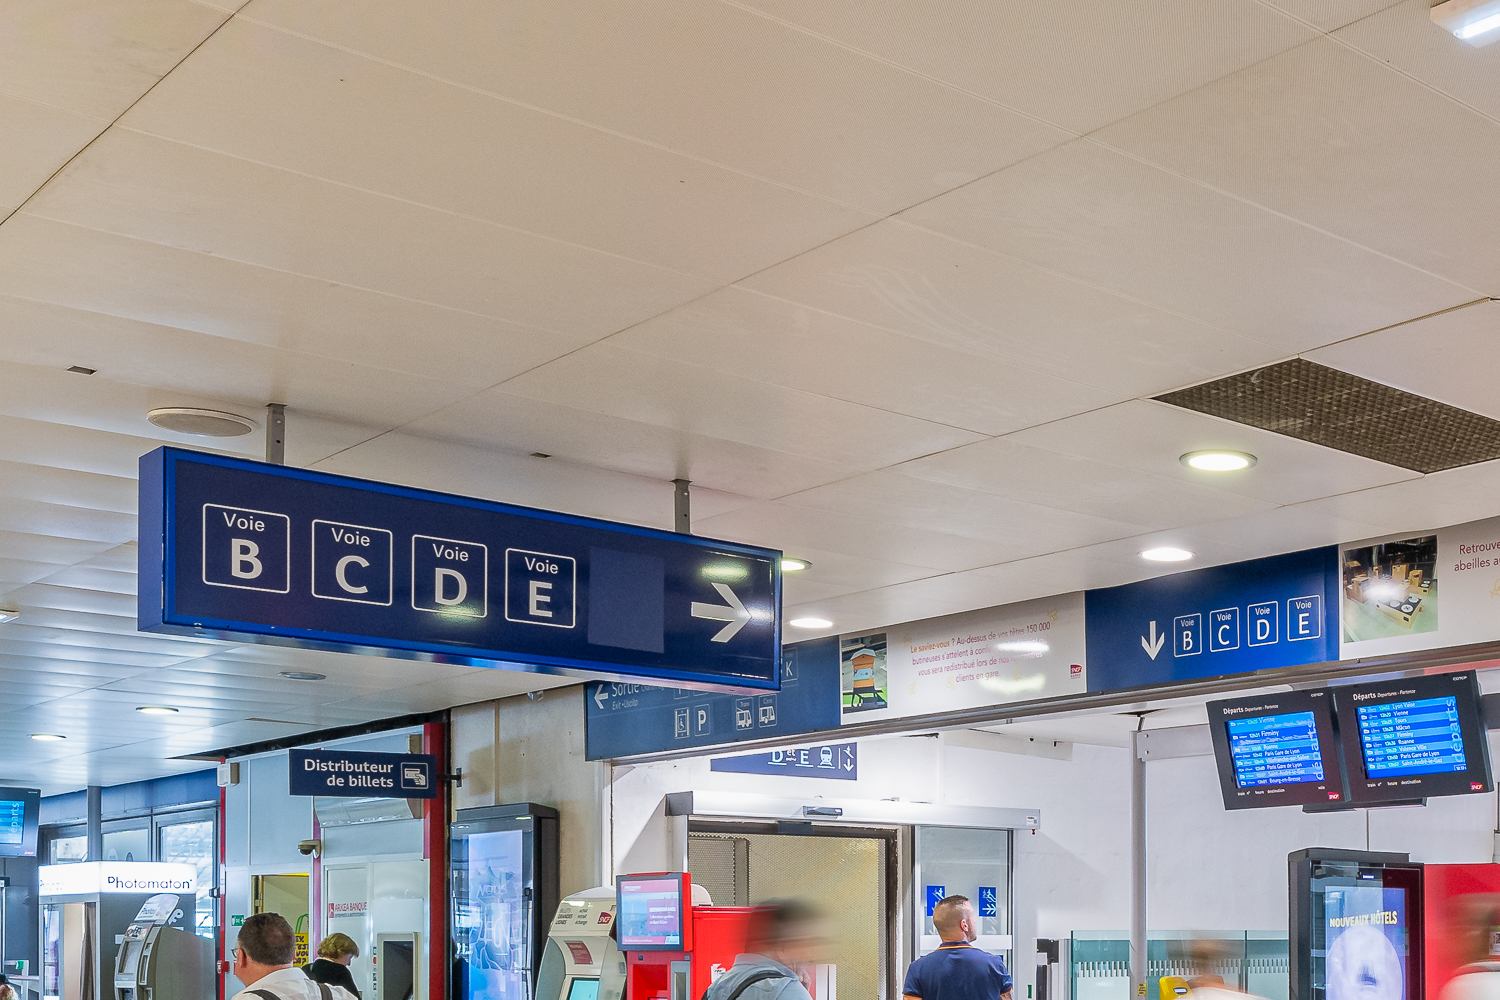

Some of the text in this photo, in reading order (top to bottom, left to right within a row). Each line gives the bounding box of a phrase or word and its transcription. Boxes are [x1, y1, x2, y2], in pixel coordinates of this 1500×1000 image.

[223, 511, 265, 532] Voie
[331, 527, 371, 548] Voie
[230, 538, 263, 580] B
[432, 543, 470, 563] Voie
[524, 556, 559, 576] Voie
[1454, 554, 1491, 572] abeilles
[335, 554, 371, 595] C
[434, 566, 467, 607] D
[528, 580, 553, 618] E
[1295, 600, 1312, 611] Voie
[1216, 612, 1232, 622] Voie
[1255, 606, 1270, 617] Voie
[1180, 617, 1195, 627] Voie
[1256, 618, 1270, 640] D
[1298, 613, 1311, 635] E
[910, 620, 1051, 654] Le saviez-vous Au-dessus de têtes 150 000
[1183, 630, 1193, 651] B
[1218, 624, 1230, 646] C
[785, 661, 793, 677] K
[912, 653, 941, 666] butineuses
[918, 655, 997, 676] vous sera redistribué lors de
[956, 669, 1000, 683] clients en gare.
[1353, 692, 1377, 700] Départs
[1223, 706, 1244, 715] Départs
[304, 758, 394, 773] Distributeur
[800, 750, 810, 765] E
[326, 774, 394, 788] de billets
[107, 876, 190, 889] Photomaton
[1329, 909, 1398, 928] NOUVEAUX HÔTELS
